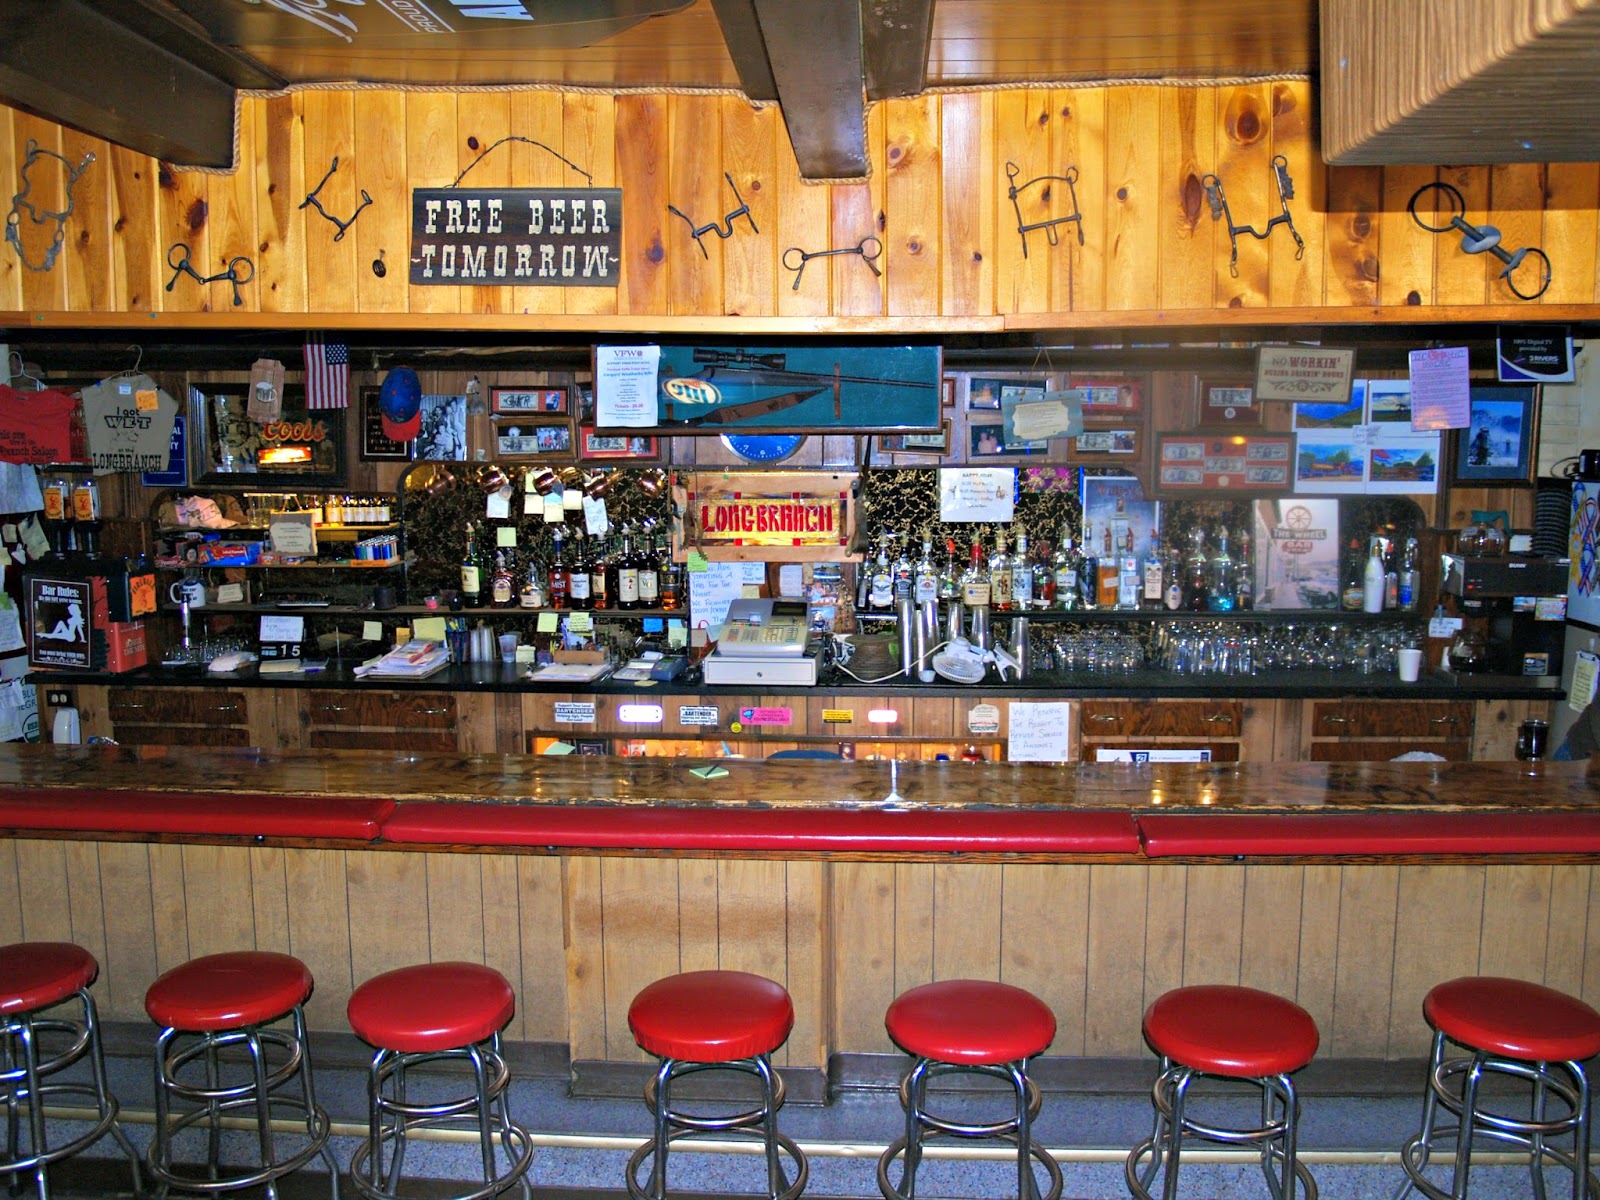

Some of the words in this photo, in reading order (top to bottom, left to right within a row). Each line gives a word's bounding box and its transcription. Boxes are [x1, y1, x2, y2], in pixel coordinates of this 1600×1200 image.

[425, 199, 503, 235] FREE
[528, 199, 610, 235] BEER
[1272, 357, 1287, 367] NO
[117, 407, 120, 415] I
[123, 408, 139, 417] got
[104, 416, 151, 429] WET
[263, 418, 329, 442] Coors
[92, 453, 161, 470] LONGBRANCH
[1273, 529, 1290, 539] THE
[1294, 530, 1326, 539] WHEEL
[42, 585, 56, 595] Bar
[57, 586, 79, 598] Rules:
